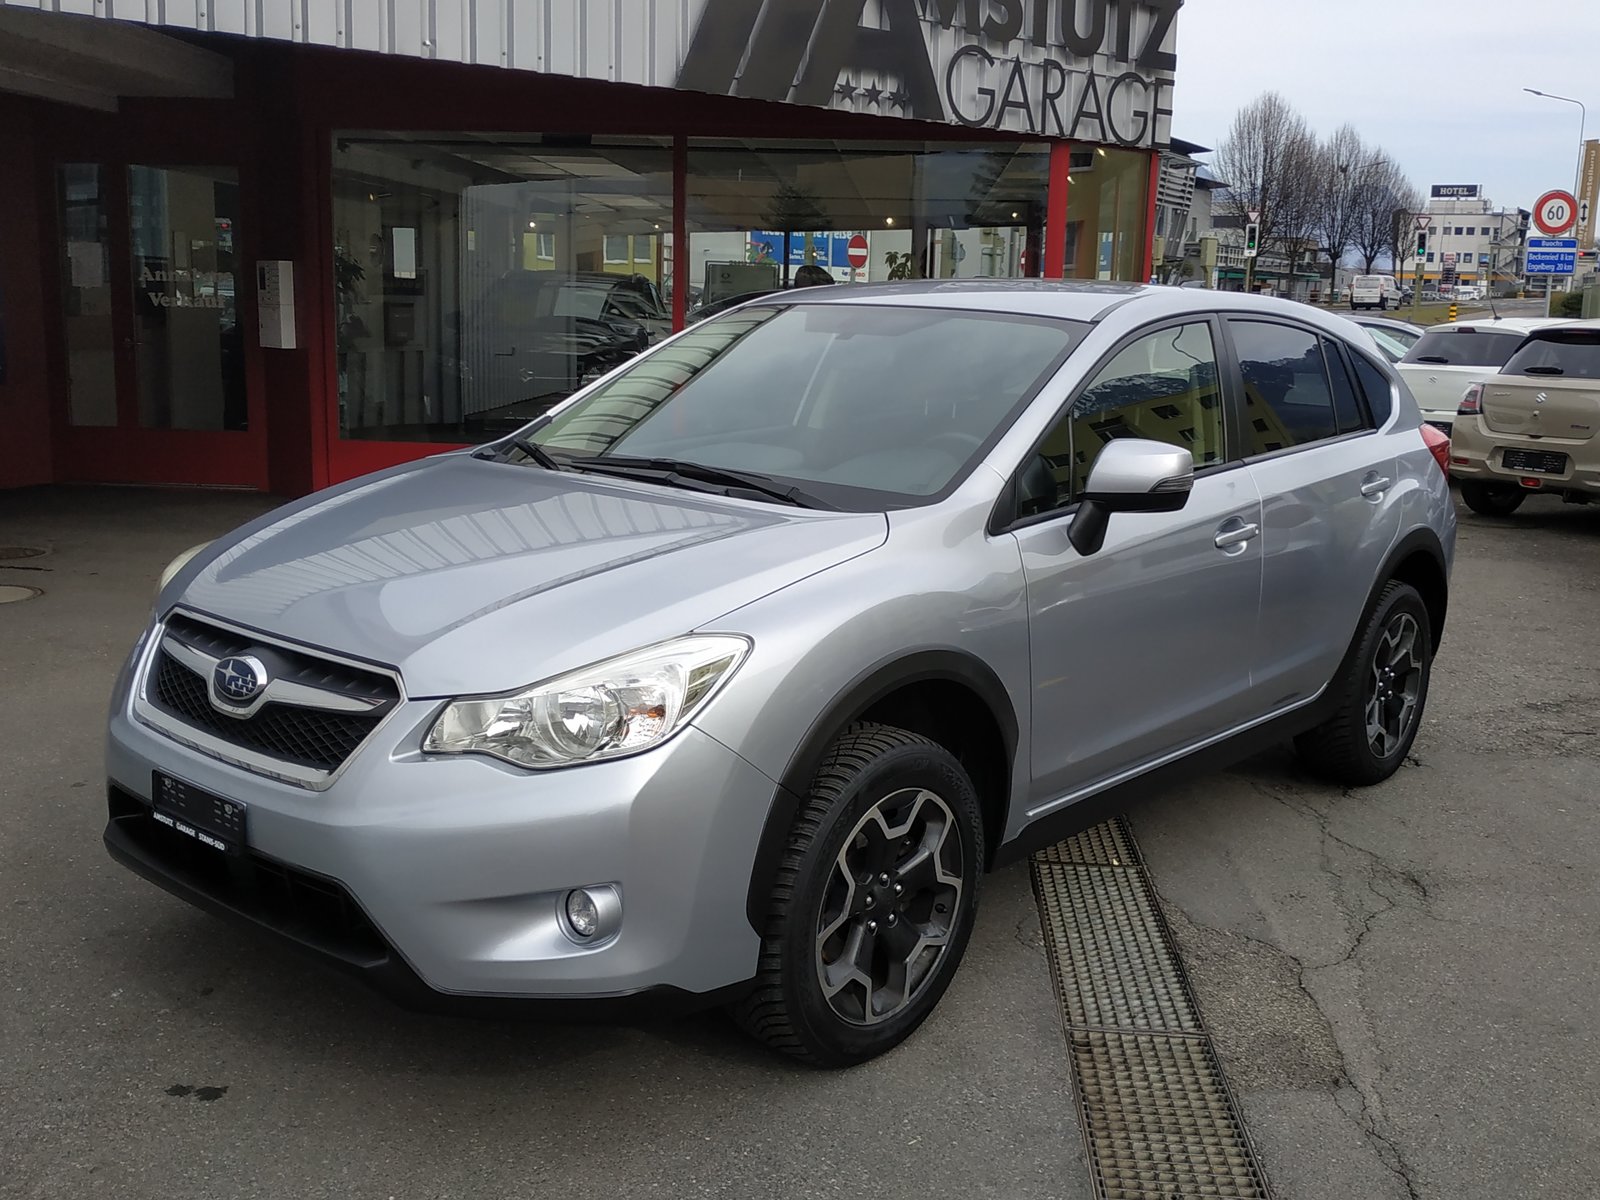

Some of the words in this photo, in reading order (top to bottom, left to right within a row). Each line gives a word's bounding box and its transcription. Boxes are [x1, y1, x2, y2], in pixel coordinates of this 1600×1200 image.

[946, 44, 1176, 150] GARAGE
[1440, 187, 1469, 195] HOTEL
[1547, 205, 1565, 220] 60
[1528, 253, 1559, 261] Beckenried
[1565, 253, 1574, 261] km
[1527, 262, 1555, 272] Engelberg
[1564, 262, 1572, 270] km
